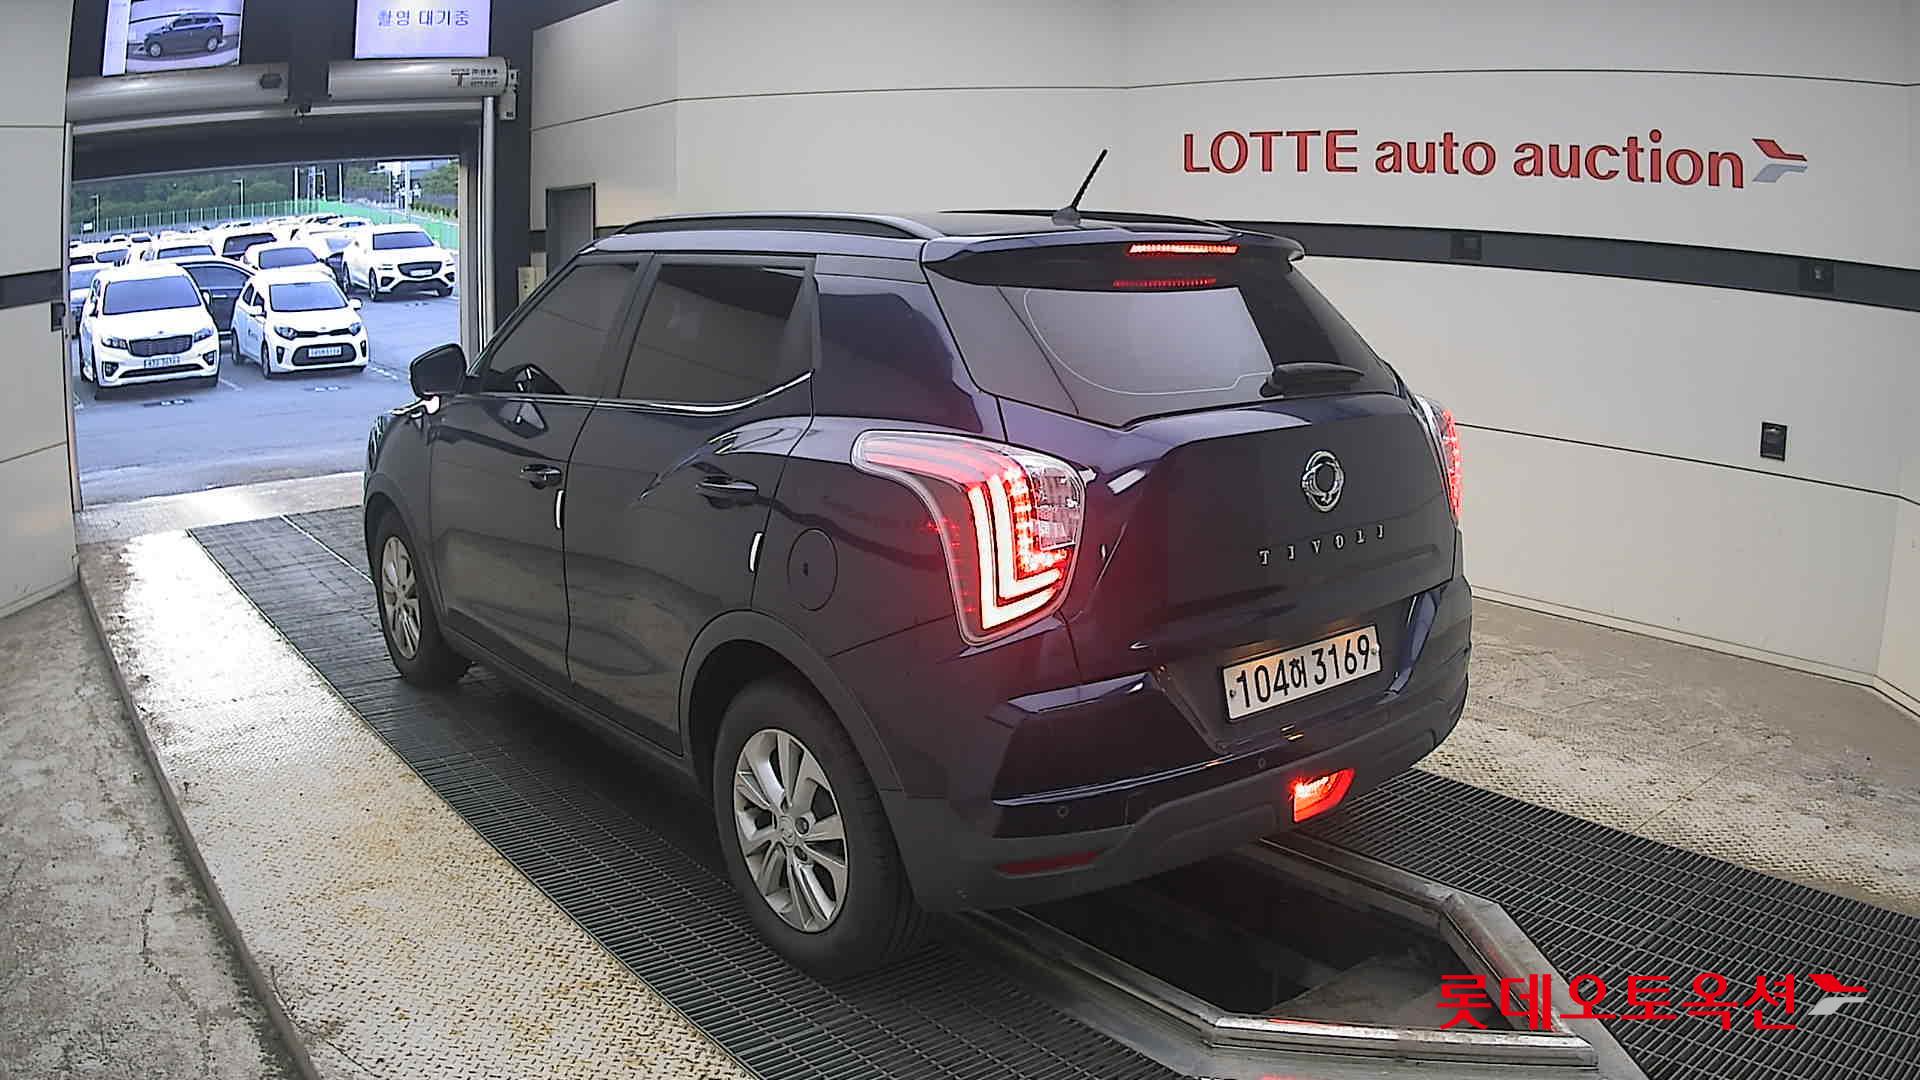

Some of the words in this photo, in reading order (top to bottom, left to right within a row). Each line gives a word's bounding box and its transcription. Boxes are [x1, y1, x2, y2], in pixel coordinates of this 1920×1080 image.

[1183, 129, 1358, 173] LOTTE
[1375, 131, 1497, 175] auto
[1513, 129, 1745, 189] auction
[1258, 524, 1385, 566] TIVOLI
[1311, 634, 1370, 686] 3169
